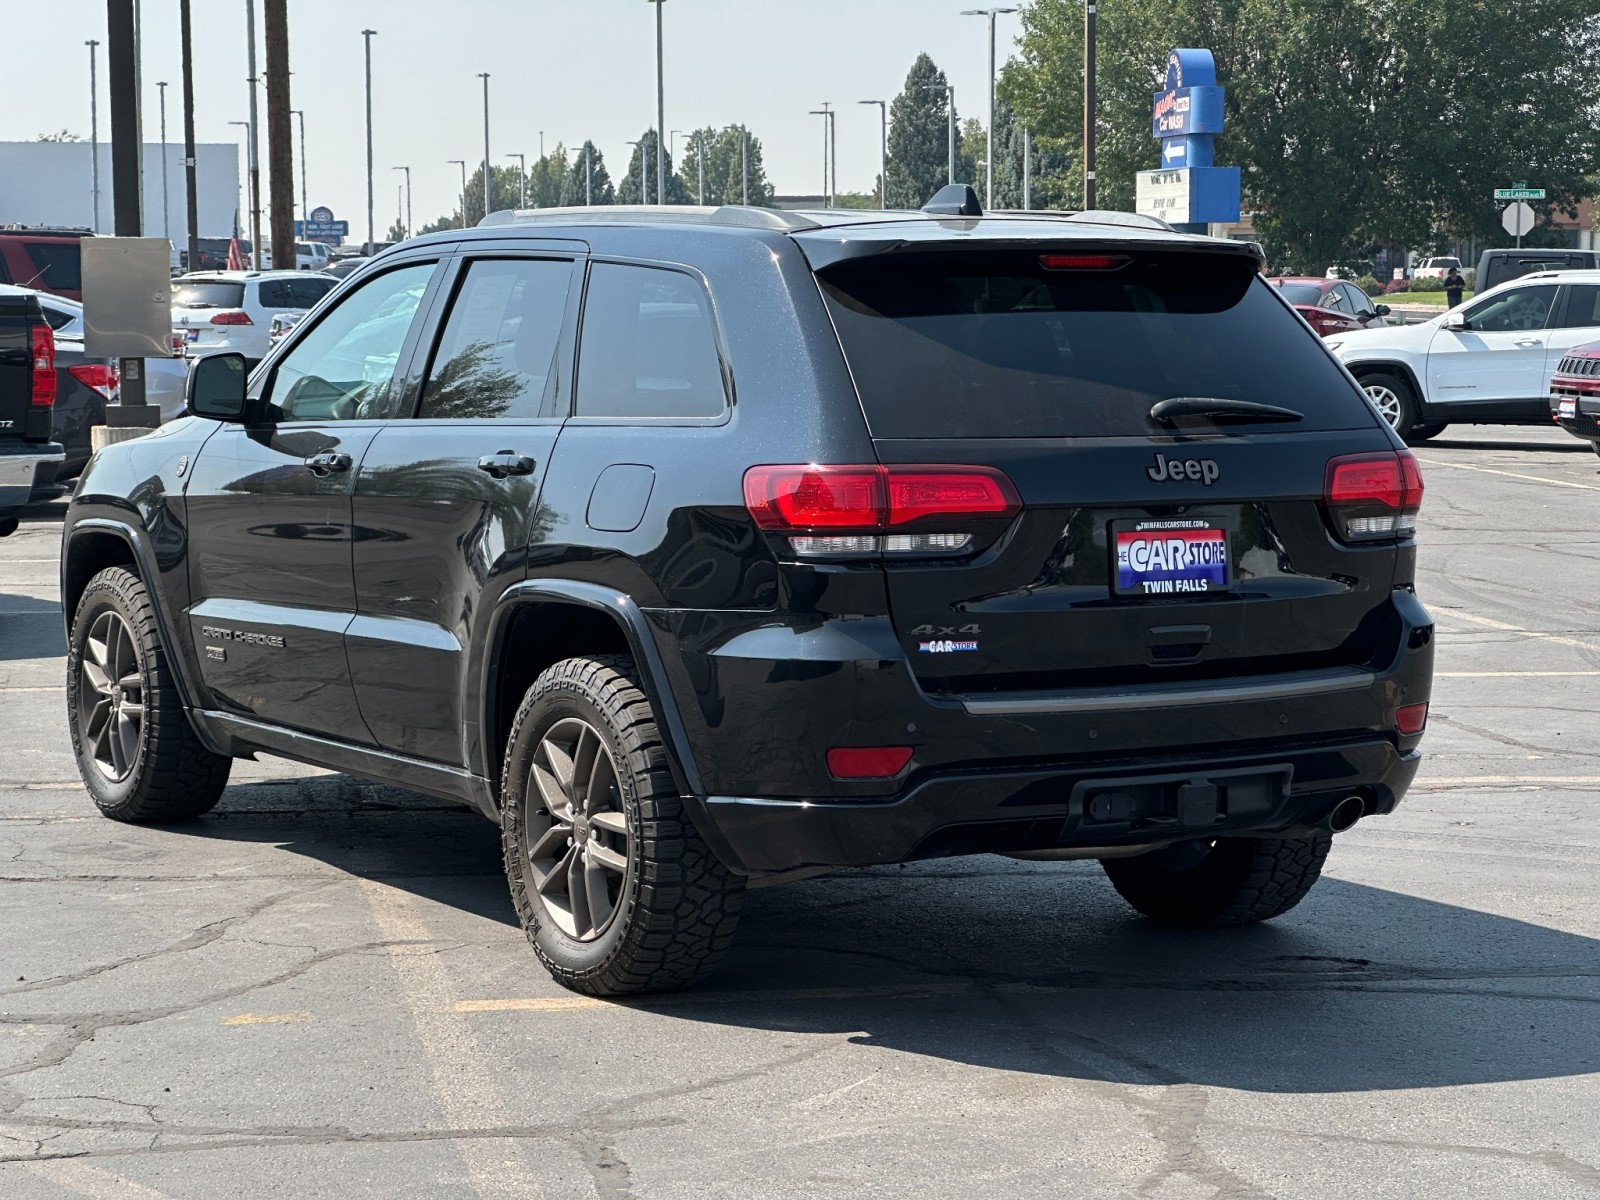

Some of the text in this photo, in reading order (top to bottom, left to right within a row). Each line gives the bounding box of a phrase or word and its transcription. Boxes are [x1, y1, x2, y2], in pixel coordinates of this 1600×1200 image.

[1494, 190, 1511, 198] BLUE
[1511, 190, 1530, 198] LAKES
[1540, 189, 1546, 198] N
[0, 420, 14, 428] TZ
[1147, 453, 1220, 485] Jeep
[1140, 520, 1204, 529] TWINFALLSCARSTORE.COM
[1118, 538, 1225, 573] HE CAR STORE
[1143, 578, 1208, 594] TWIN FALLS
[203, 625, 286, 648] GRAND CHEROKEE
[928, 640, 953, 653] CAR
[953, 641, 976, 650] STORE
